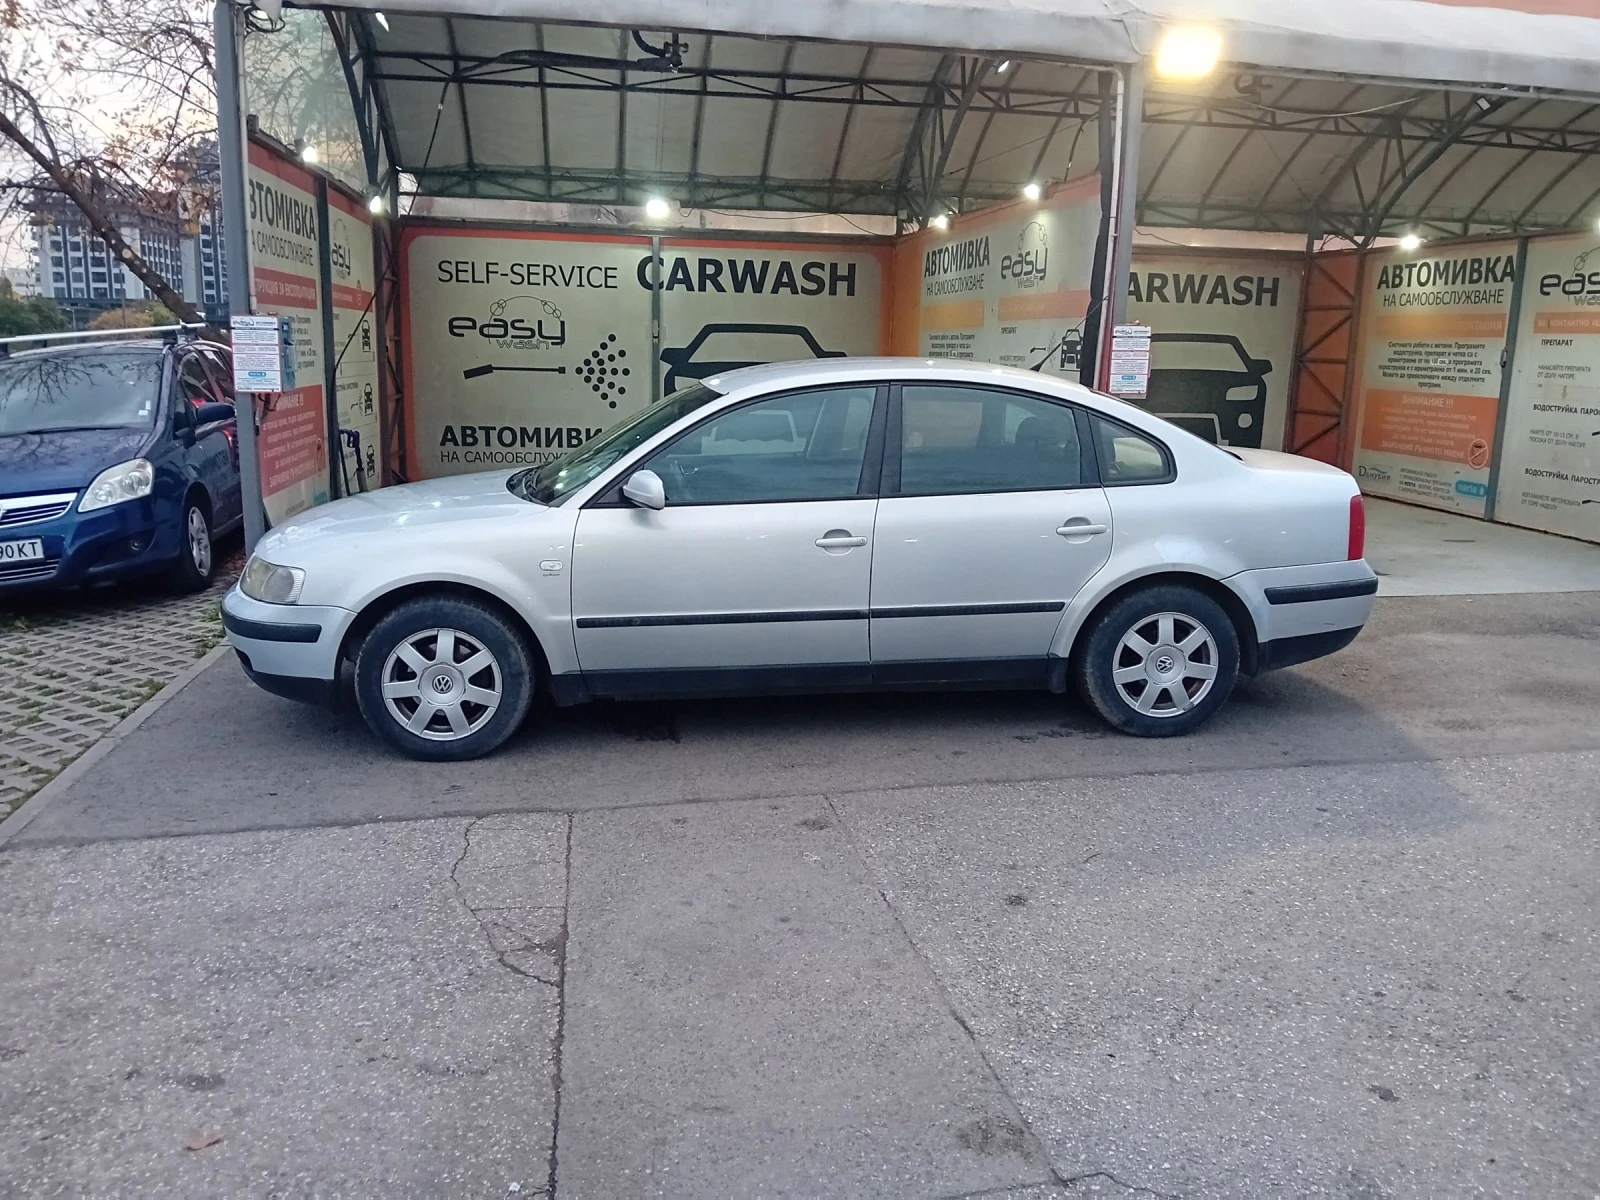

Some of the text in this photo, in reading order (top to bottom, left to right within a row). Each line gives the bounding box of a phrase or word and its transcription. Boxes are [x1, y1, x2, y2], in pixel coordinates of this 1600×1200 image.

[249, 178, 316, 241] ВТОМИВКА
[331, 242, 351, 276] asy
[924, 236, 990, 278] АВТОМИВКА
[1001, 247, 1048, 281] easy
[437, 255, 857, 297] SELF-SERVICE CARWASH
[1377, 255, 1515, 290] АВТОМИВКА
[926, 273, 985, 296] НА САМООБСЛУЖВАНЕ
[1127, 271, 1280, 307] ARWASH
[1540, 272, 1600, 296] eas
[1383, 289, 1505, 307] НА САМООБСЛУЖВАНЕ
[448, 316, 566, 345] easy
[496, 339, 550, 350] wash
[1454, 342, 1486, 350] Програмите
[1541, 339, 1574, 347] ПРЕПАРАТ
[1441, 374, 1457, 382] между
[1402, 395, 1445, 408] ВНИМАНИЕ
[1533, 403, 1578, 414] ВОДОСТРУЙКА
[439, 425, 602, 448] АВТОМИВК
[440, 451, 460, 463] НА
[1382, 440, 1414, 451] ЗАБРАНЕНО
[1414, 445, 1442, 456] РЪЧНОТО
[1524, 467, 1569, 481] ВОДОСТРУЙКА
[17, 541, 38, 558] KT
[432, 674, 454, 695] VW
